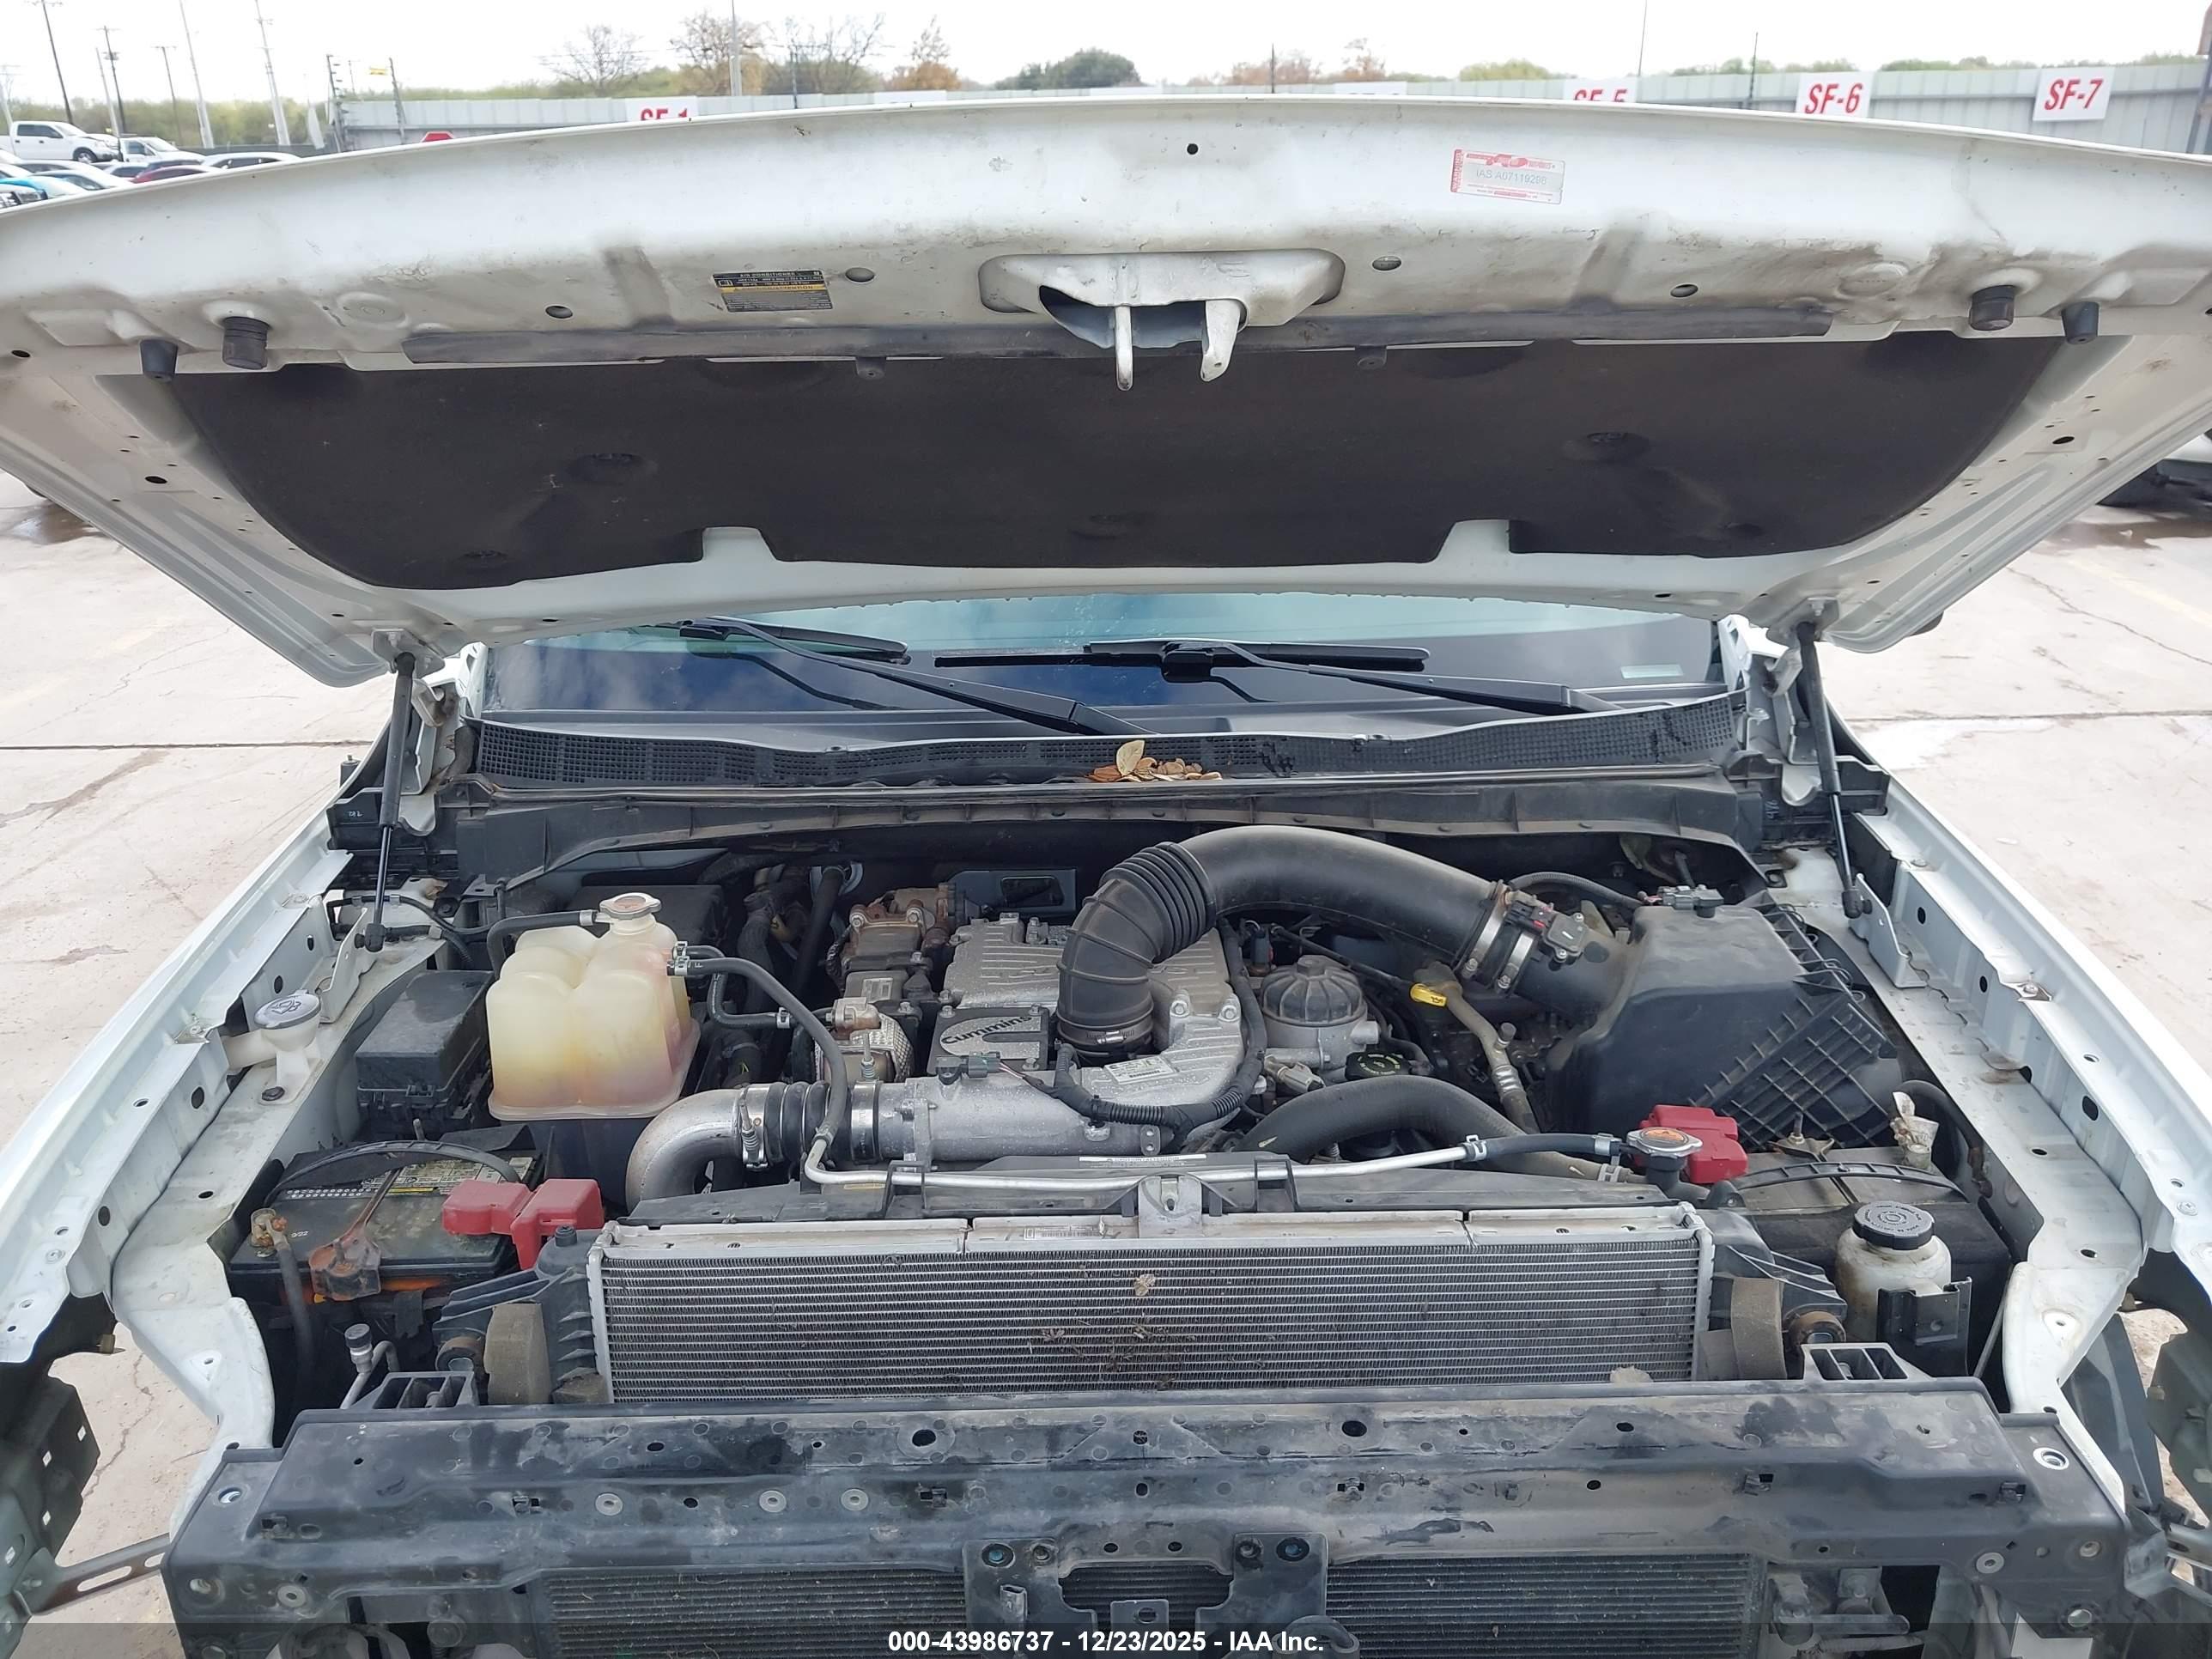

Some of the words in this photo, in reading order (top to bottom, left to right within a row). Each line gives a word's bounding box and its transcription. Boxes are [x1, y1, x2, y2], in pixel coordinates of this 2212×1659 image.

[1804, 82, 1863, 114] SF-6
[2045, 78, 2104, 110] SF-7
[941, 1016, 1032, 1044] Cummins
